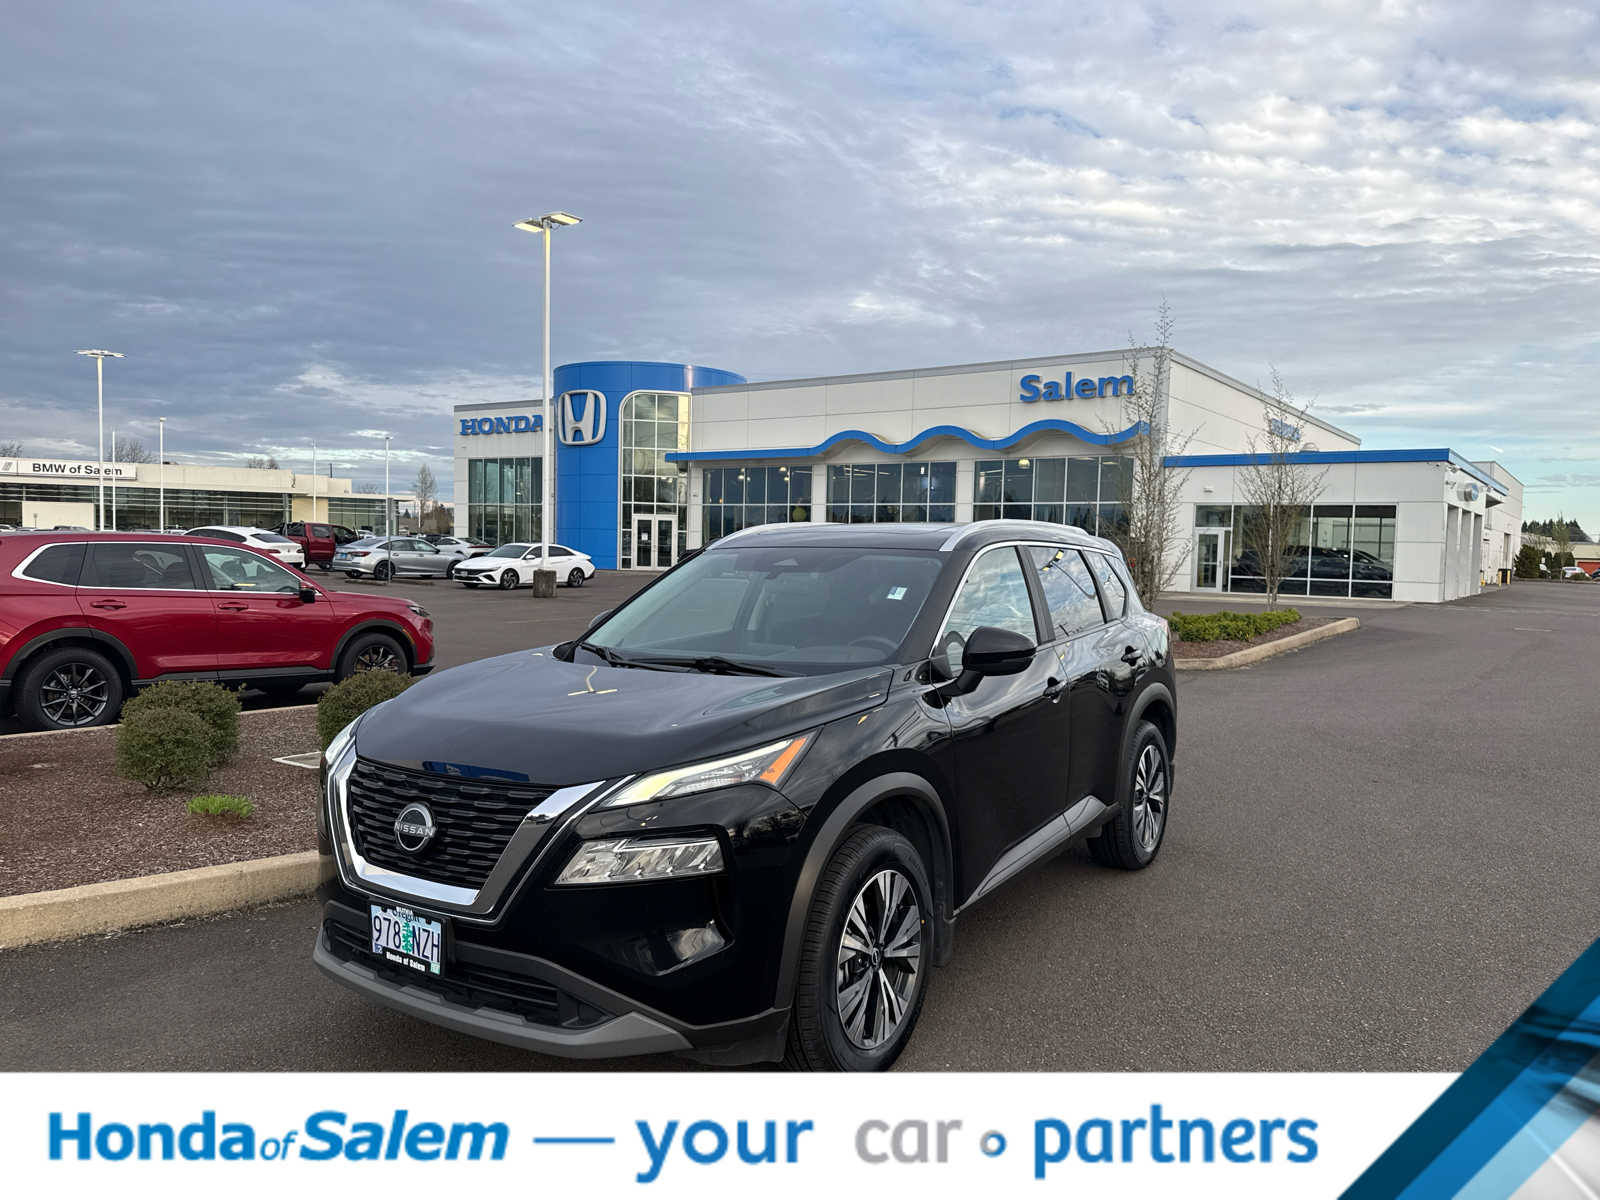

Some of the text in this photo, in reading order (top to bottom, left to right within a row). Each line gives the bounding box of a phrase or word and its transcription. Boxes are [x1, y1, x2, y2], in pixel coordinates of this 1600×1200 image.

[1019, 371, 1135, 403] Salem
[460, 414, 543, 435] HONDA
[32, 462, 122, 476] BMW of Saem
[394, 820, 435, 837] NISSAN
[374, 914, 441, 963] 978 NZH
[386, 951, 403, 964] Honda
[403, 957, 409, 966] of
[409, 959, 426, 972] Salem
